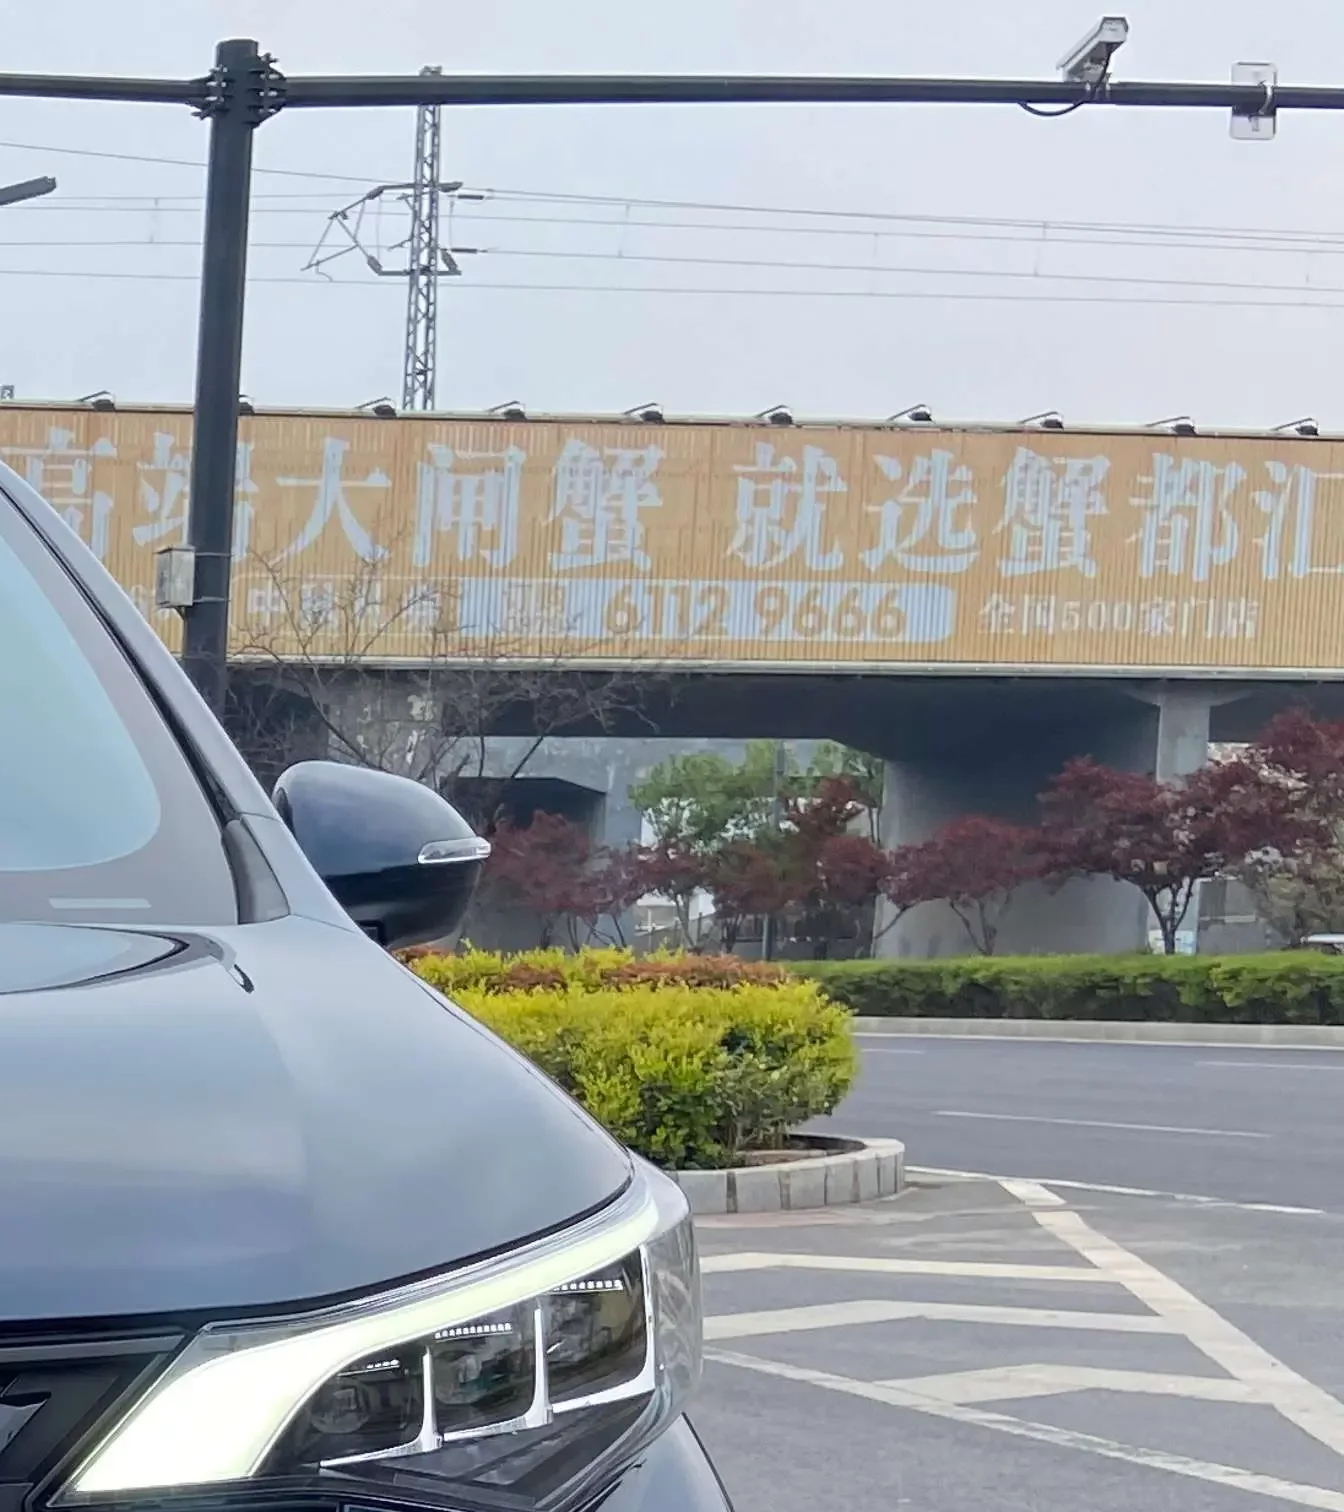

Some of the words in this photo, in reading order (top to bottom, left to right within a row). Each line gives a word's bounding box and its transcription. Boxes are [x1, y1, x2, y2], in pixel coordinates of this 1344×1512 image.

[724, 440, 1344, 582] 就选蟹都汇
[604, 583, 730, 636] 6112
[754, 584, 907, 640] 9666
